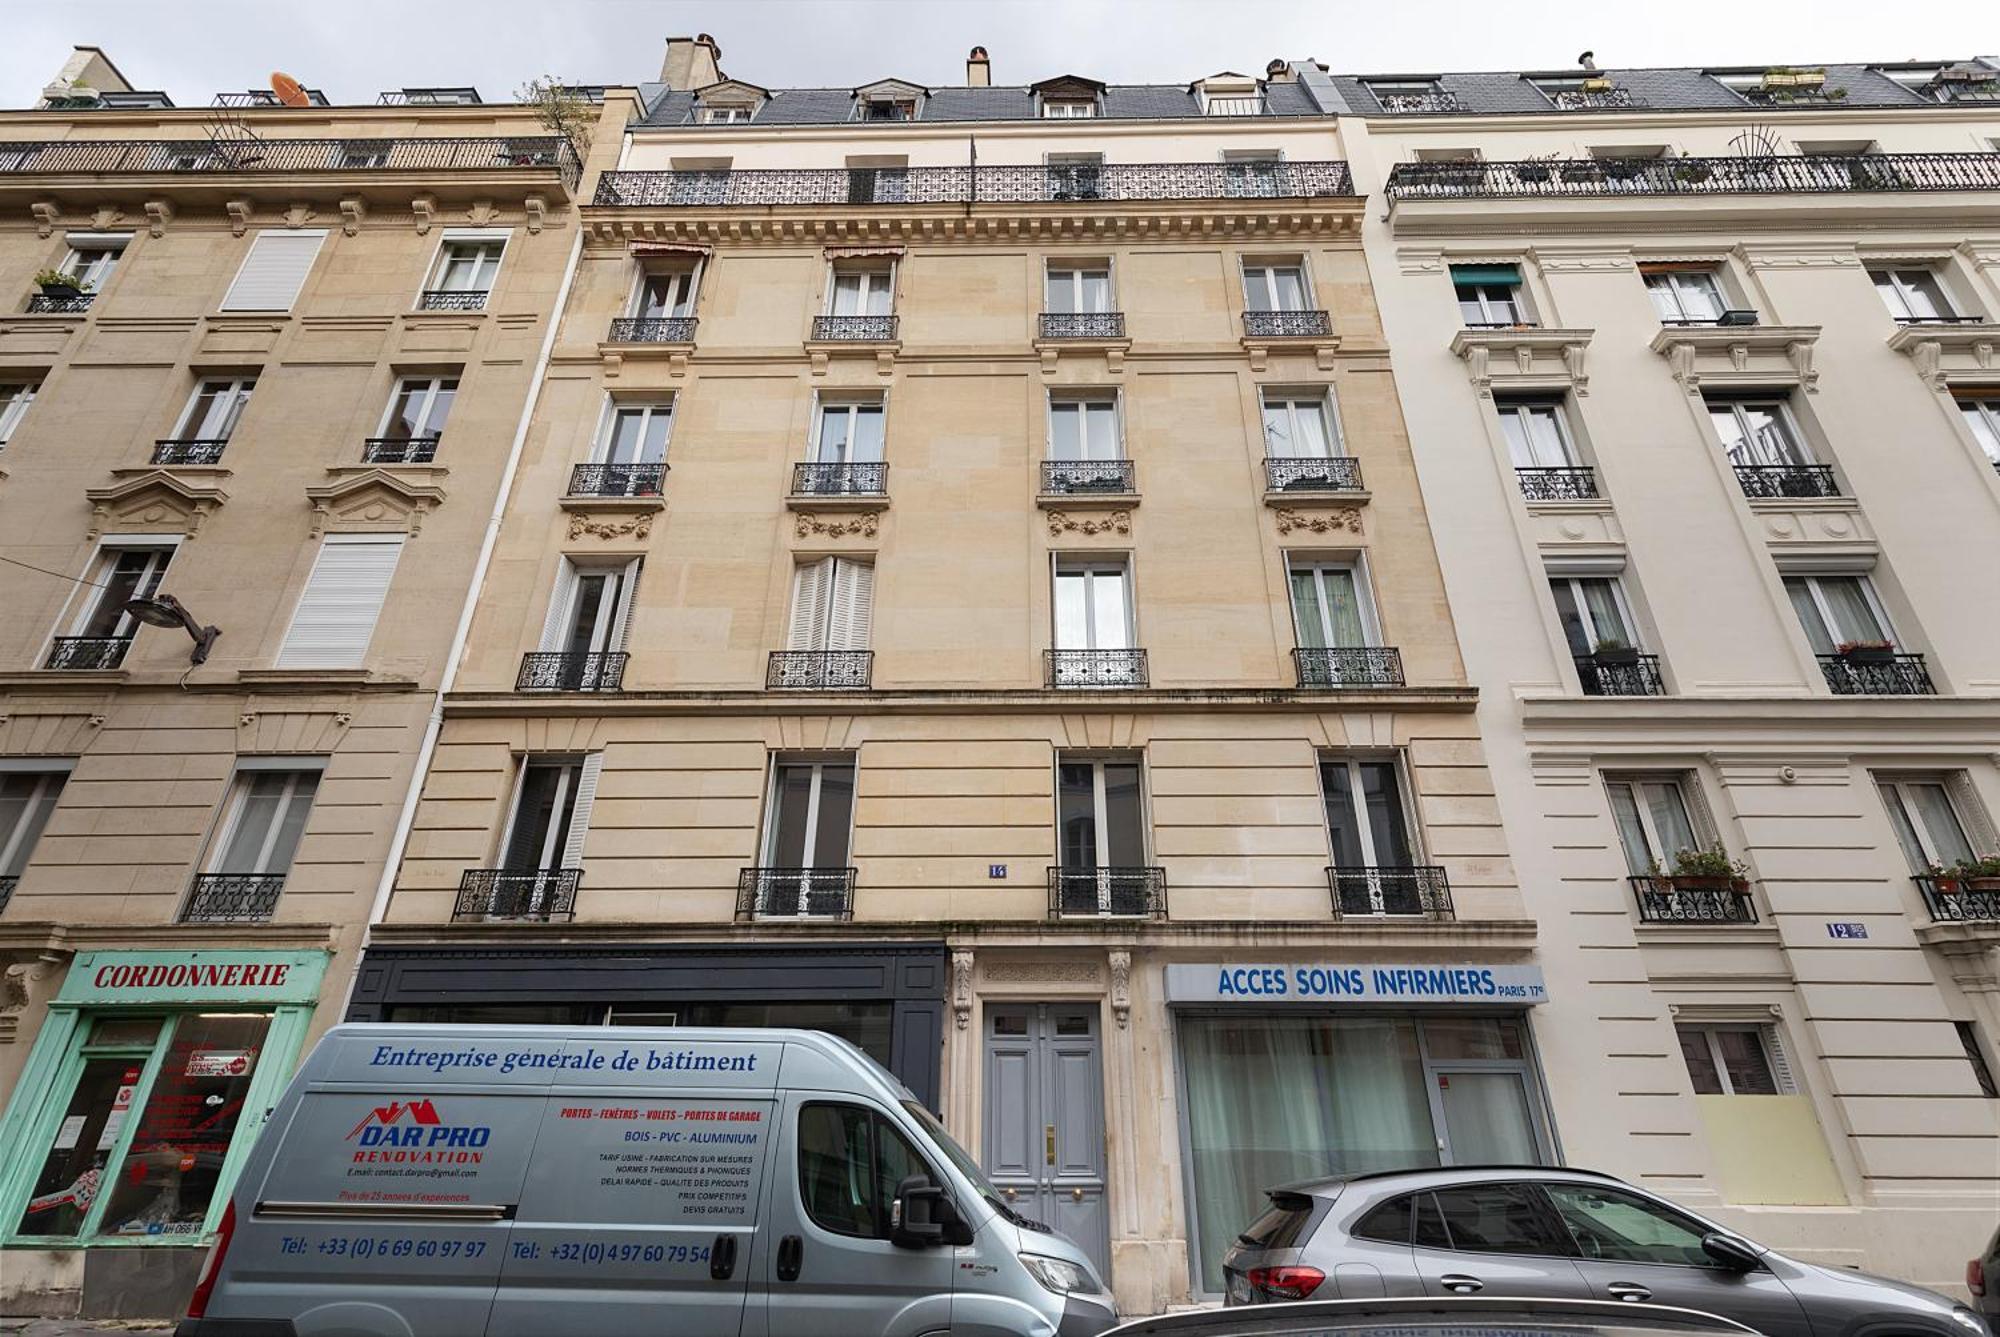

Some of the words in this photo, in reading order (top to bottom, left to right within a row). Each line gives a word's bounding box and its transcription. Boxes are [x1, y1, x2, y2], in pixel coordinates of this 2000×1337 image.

[1831, 924, 1849, 938] 12
[94, 964, 290, 988] CORDONNERIE
[1218, 968, 1288, 996] ACCES
[1295, 968, 1364, 996] SOINS
[1373, 969, 1496, 997] INFIRMIERS
[1499, 985, 1526, 998] PARIS
[369, 1045, 498, 1074] Entreprise
[503, 1047, 606, 1074] générale
[611, 1049, 640, 1072] de
[646, 1050, 758, 1073] bâtiment
[561, 1108, 592, 1119] PORTES
[600, 1107, 639, 1120] FENÊTRES
[647, 1110, 676, 1120] VOLETS
[684, 1110, 717, 1121] PORTES
[717, 1111, 728, 1121] DE
[729, 1111, 762, 1122] GARAGE
[360, 1126, 424, 1147] DAR
[427, 1127, 491, 1147] PRO
[624, 1131, 650, 1142] BOIS
[660, 1132, 681, 1142] PVC
[689, 1132, 758, 1144] ALUMINIUM
[353, 1151, 484, 1164] RENOVATION
[600, 1153, 620, 1161] TARIF
[622, 1154, 643, 1162] USINE
[649, 1154, 698, 1163] FABRICATION
[700, 1155, 716, 1163] SUR
[717, 1156, 753, 1164] MESURES
[616, 1165, 649, 1174] NORMES
[650, 1166, 698, 1174] THERMIQUES
[707, 1167, 751, 1175] PHONIQUES
[625, 1178, 652, 1186] RAPIDE
[710, 1180, 749, 1188] PRODUITS
[338, 1190, 357, 1202] Plus
[678, 1192, 696, 1200] PRIX
[683, 1206, 706, 1214] DEVIS
[707, 1206, 745, 1215] GRATUITS
[281, 1237, 308, 1255] Tél:
[318, 1238, 348, 1256] +33
[350, 1238, 375, 1259] (0)
[378, 1239, 389, 1256] 6
[392, 1240, 414, 1257] 69
[416, 1240, 437, 1257] 60
[440, 1240, 462, 1258] 97
[465, 1241, 487, 1258] 97
[550, 1243, 579, 1261] +32
[582, 1242, 605, 1265] (0)
[607, 1244, 618, 1261] 4
[620, 1245, 642, 1262] 97
[643, 1245, 664, 1262] 60
[667, 1246, 688, 1263] 79
[689, 1246, 711, 1264] 54
